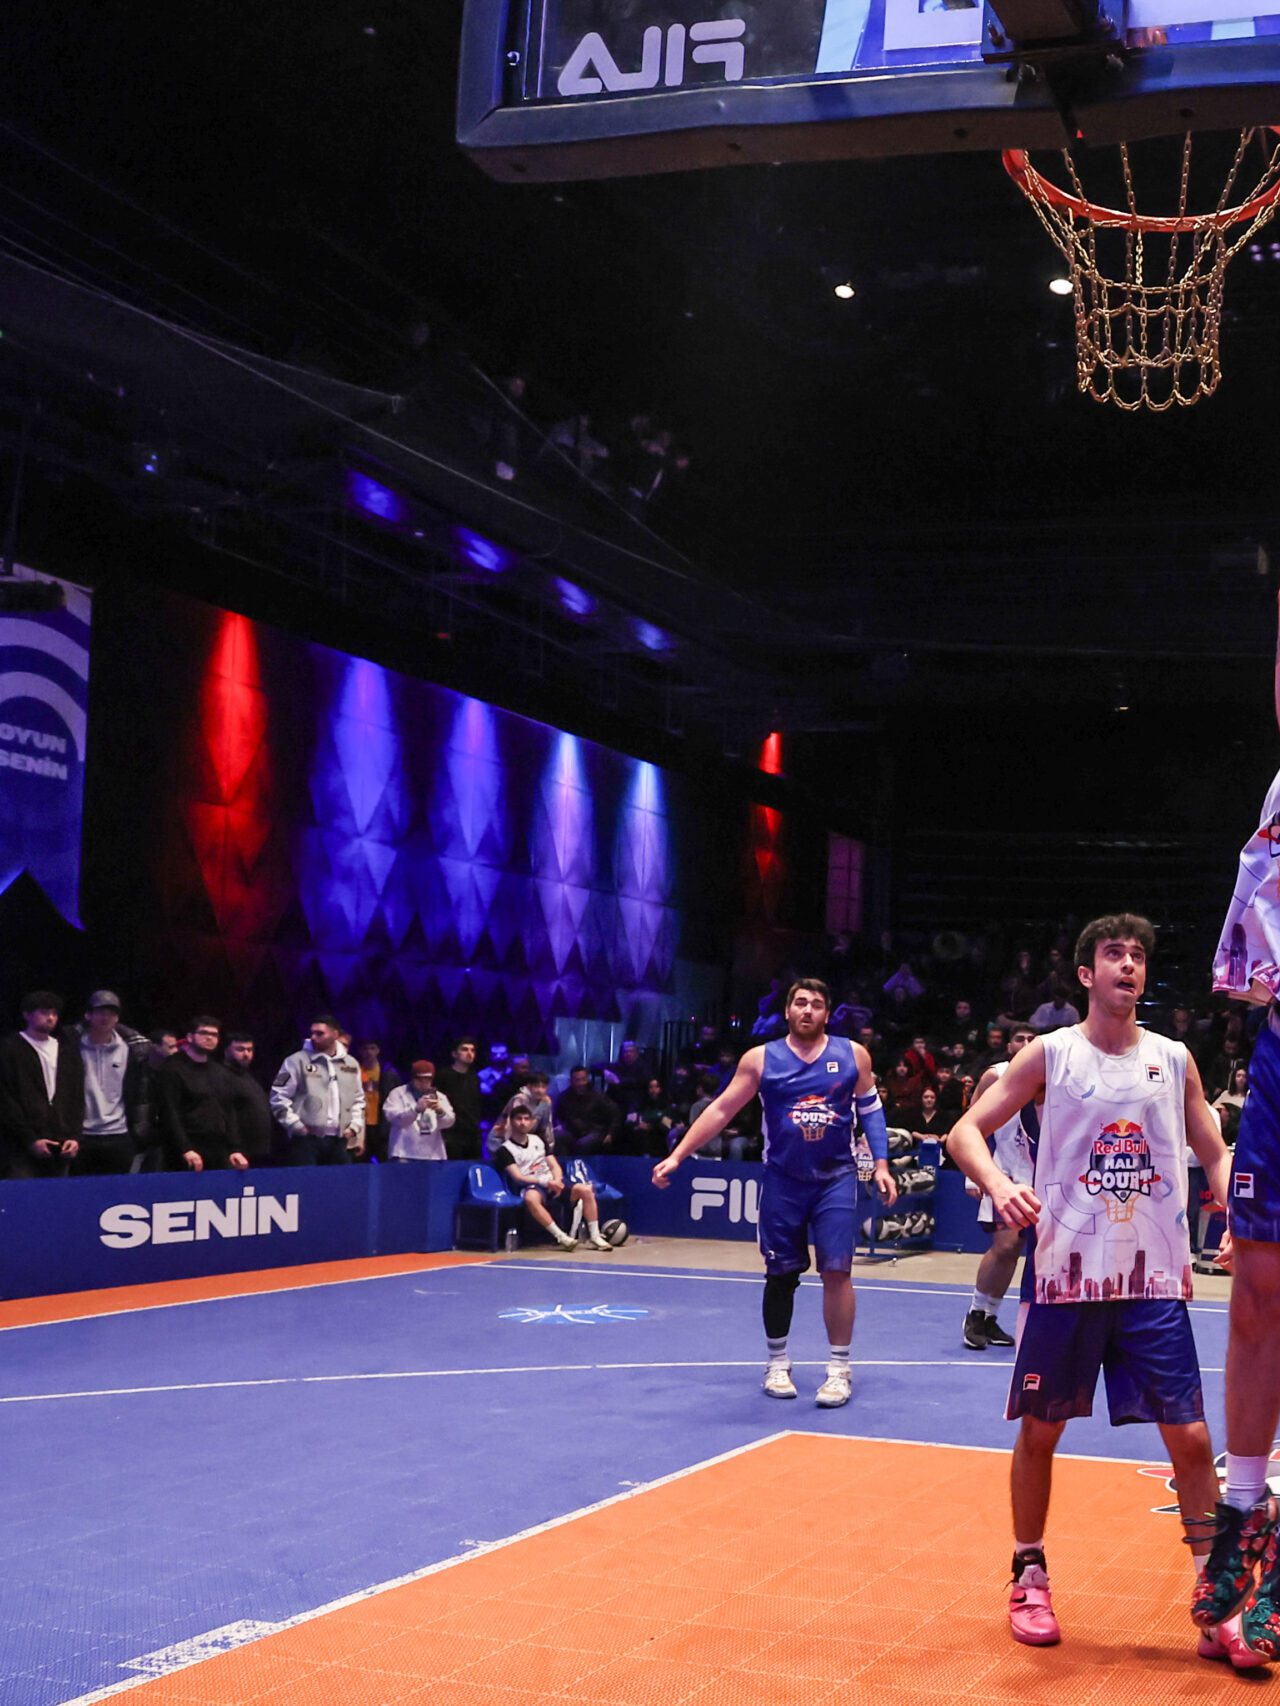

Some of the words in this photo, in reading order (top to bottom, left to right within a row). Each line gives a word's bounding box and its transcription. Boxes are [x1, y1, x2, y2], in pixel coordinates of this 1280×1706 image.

[0, 723, 67, 754] OYUN
[1094, 1139, 1121, 1154] Red
[1124, 1139, 1147, 1154] Bull
[1087, 1168, 1154, 1196] COURT
[690, 1177, 760, 1224] FIL
[99, 1186, 299, 1249] SENİN
